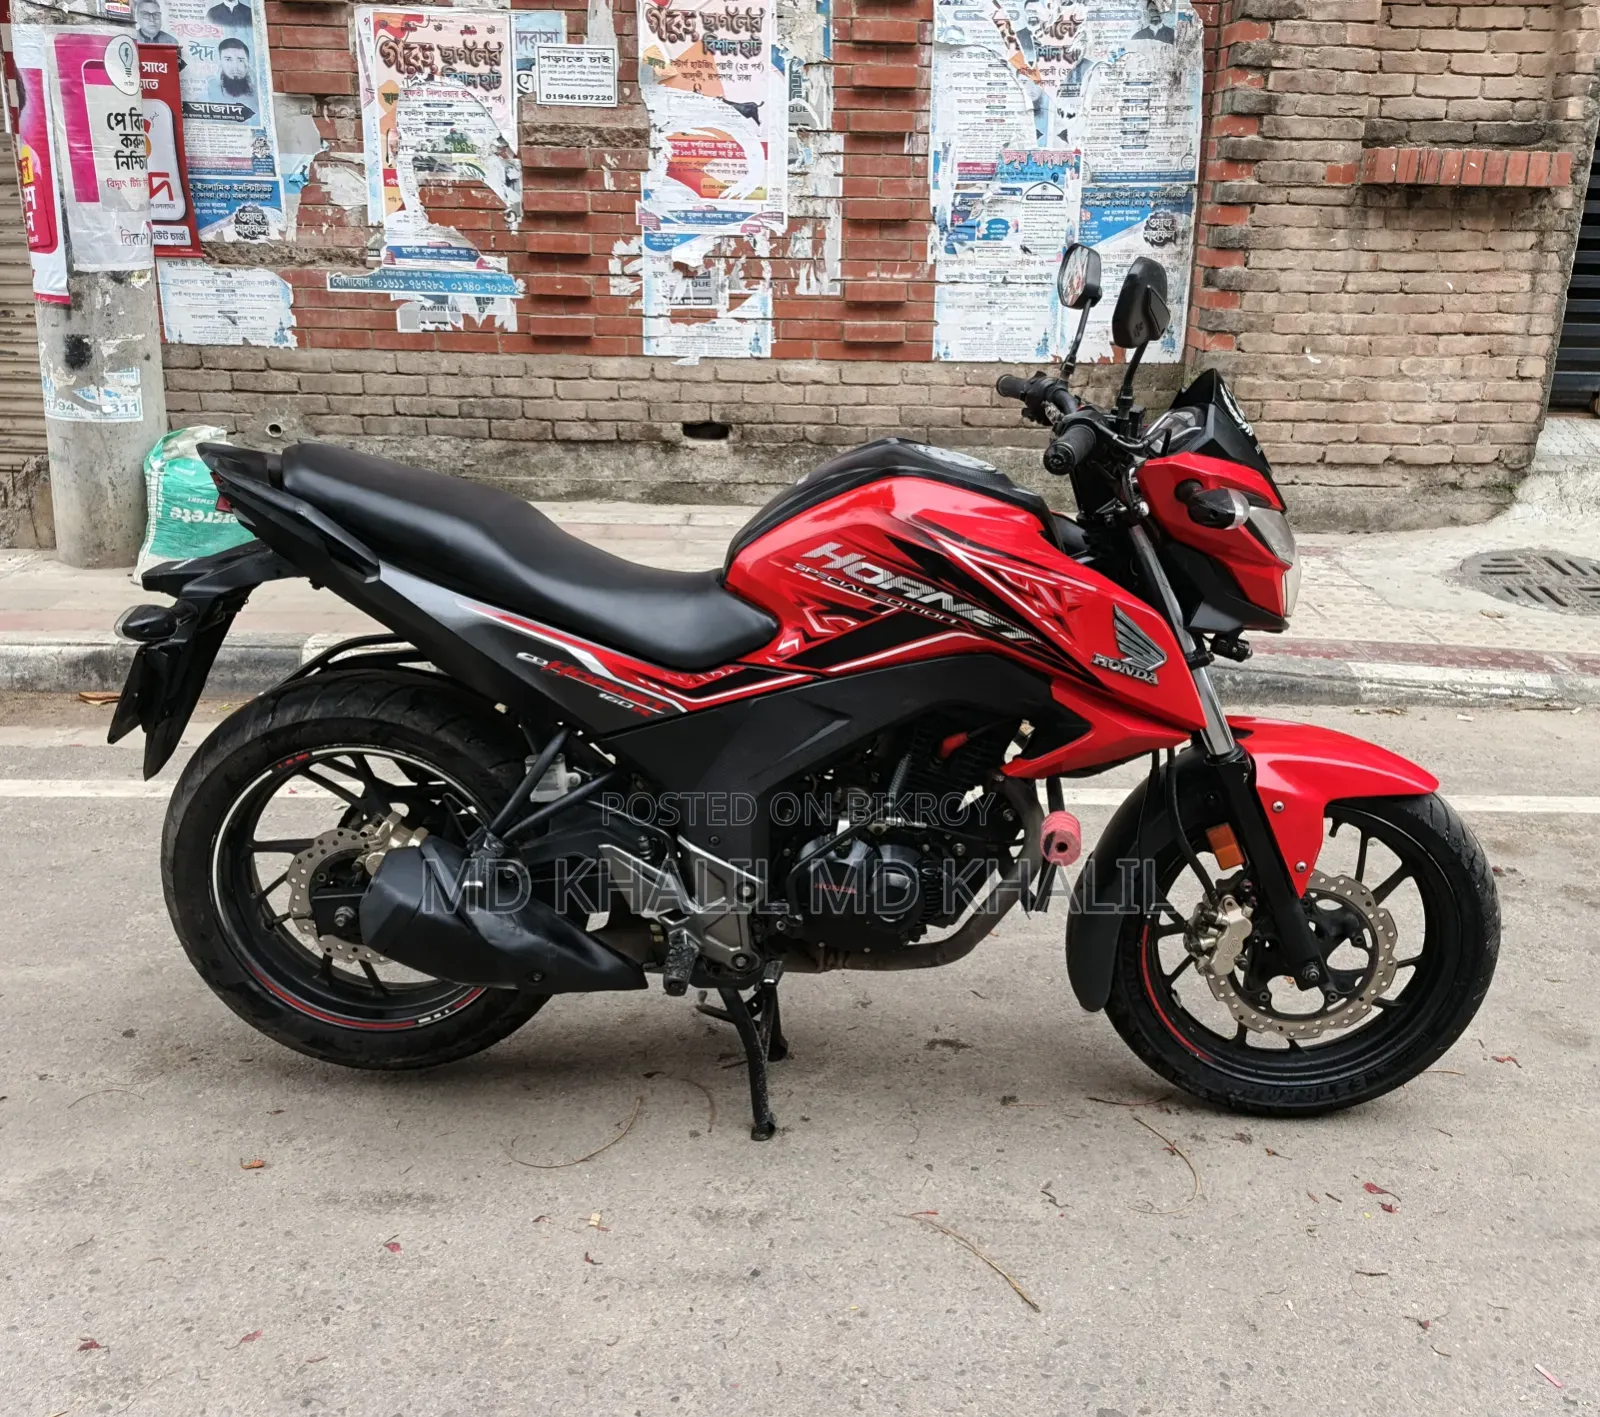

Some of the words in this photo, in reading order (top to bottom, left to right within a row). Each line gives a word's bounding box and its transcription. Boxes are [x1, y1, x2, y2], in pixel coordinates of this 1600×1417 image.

[699, 5, 767, 34] ছাগলের
[189, 40, 216, 61] ঈদ
[436, 38, 505, 68] ছাগলের
[702, 33, 739, 57] বিশাল
[738, 34, 764, 59] হাট
[141, 60, 169, 74] সাথে
[540, 54, 585, 64] পড়াতে
[587, 55, 612, 65] চাই
[478, 68, 503, 91] হাট
[736, 74, 752, 82] ঢাকা
[545, 93, 613, 101] 01946197220
[190, 102, 244, 116] আজাদ
[792, 561, 875, 598] SPECIAL
[873, 592, 961, 625] EDITION
[1091, 652, 1160, 686] HONDA
[540, 659, 672, 712] HORNET
